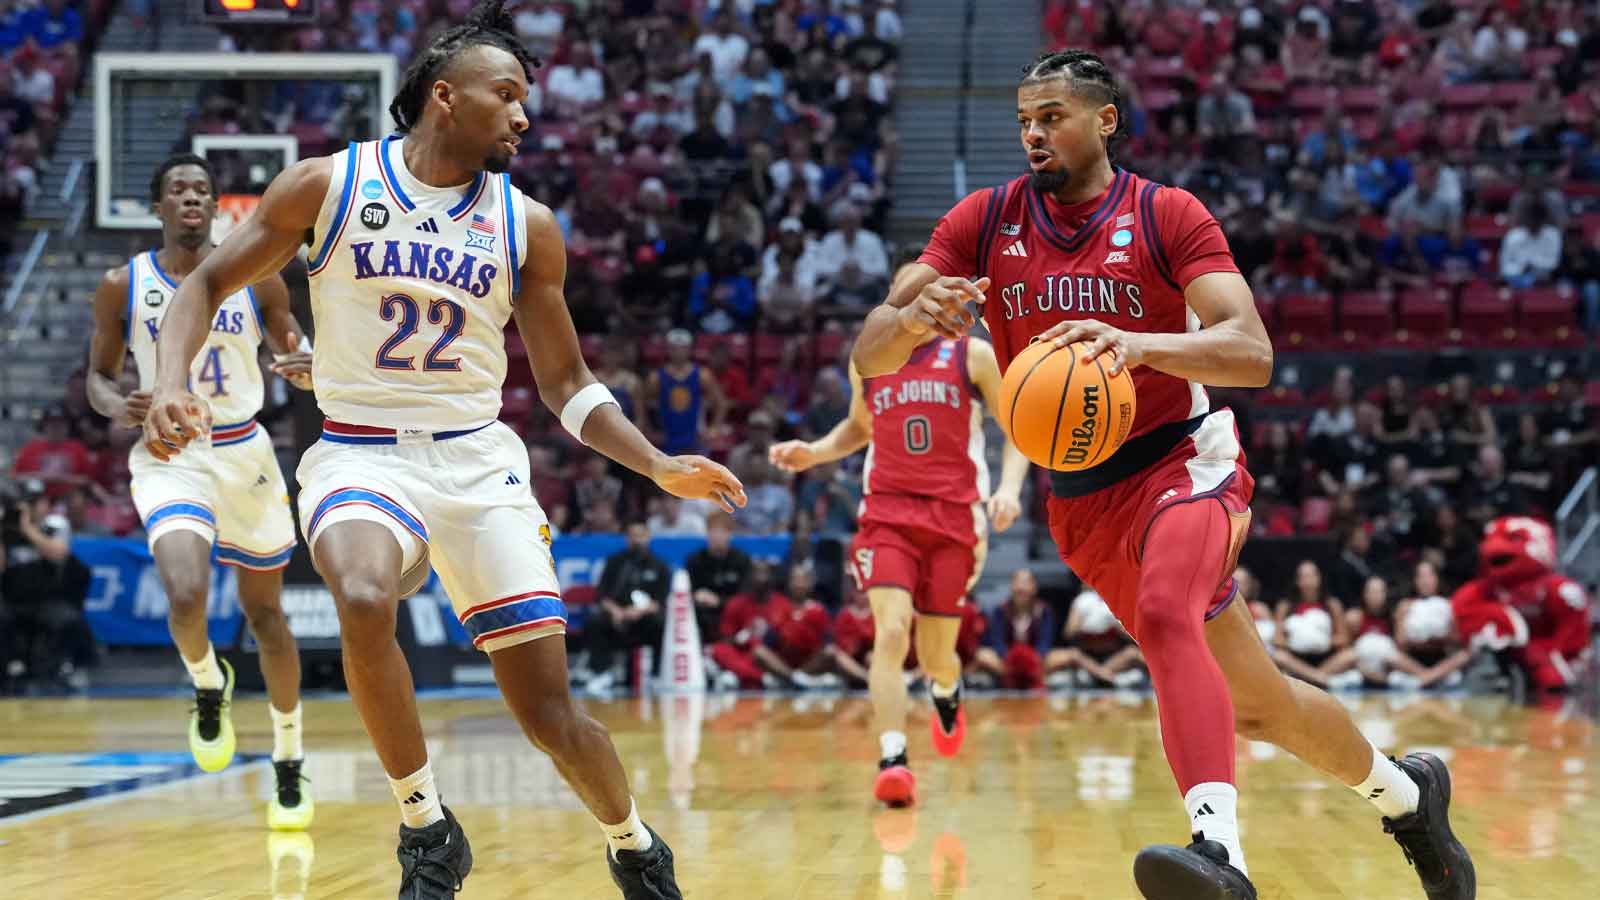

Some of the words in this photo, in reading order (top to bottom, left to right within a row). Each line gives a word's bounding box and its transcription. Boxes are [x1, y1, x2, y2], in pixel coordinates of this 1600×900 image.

[363, 207, 387, 225] SW
[350, 240, 498, 299] KANSAS
[1001, 283, 1030, 321] ST.
[1037, 275, 1144, 319] JOHN'S
[144, 308, 245, 343] KAS
[375, 293, 467, 372] 22
[896, 379, 961, 410] JOHN'S
[904, 413, 933, 456] 0
[1062, 384, 1099, 465] Wilson
